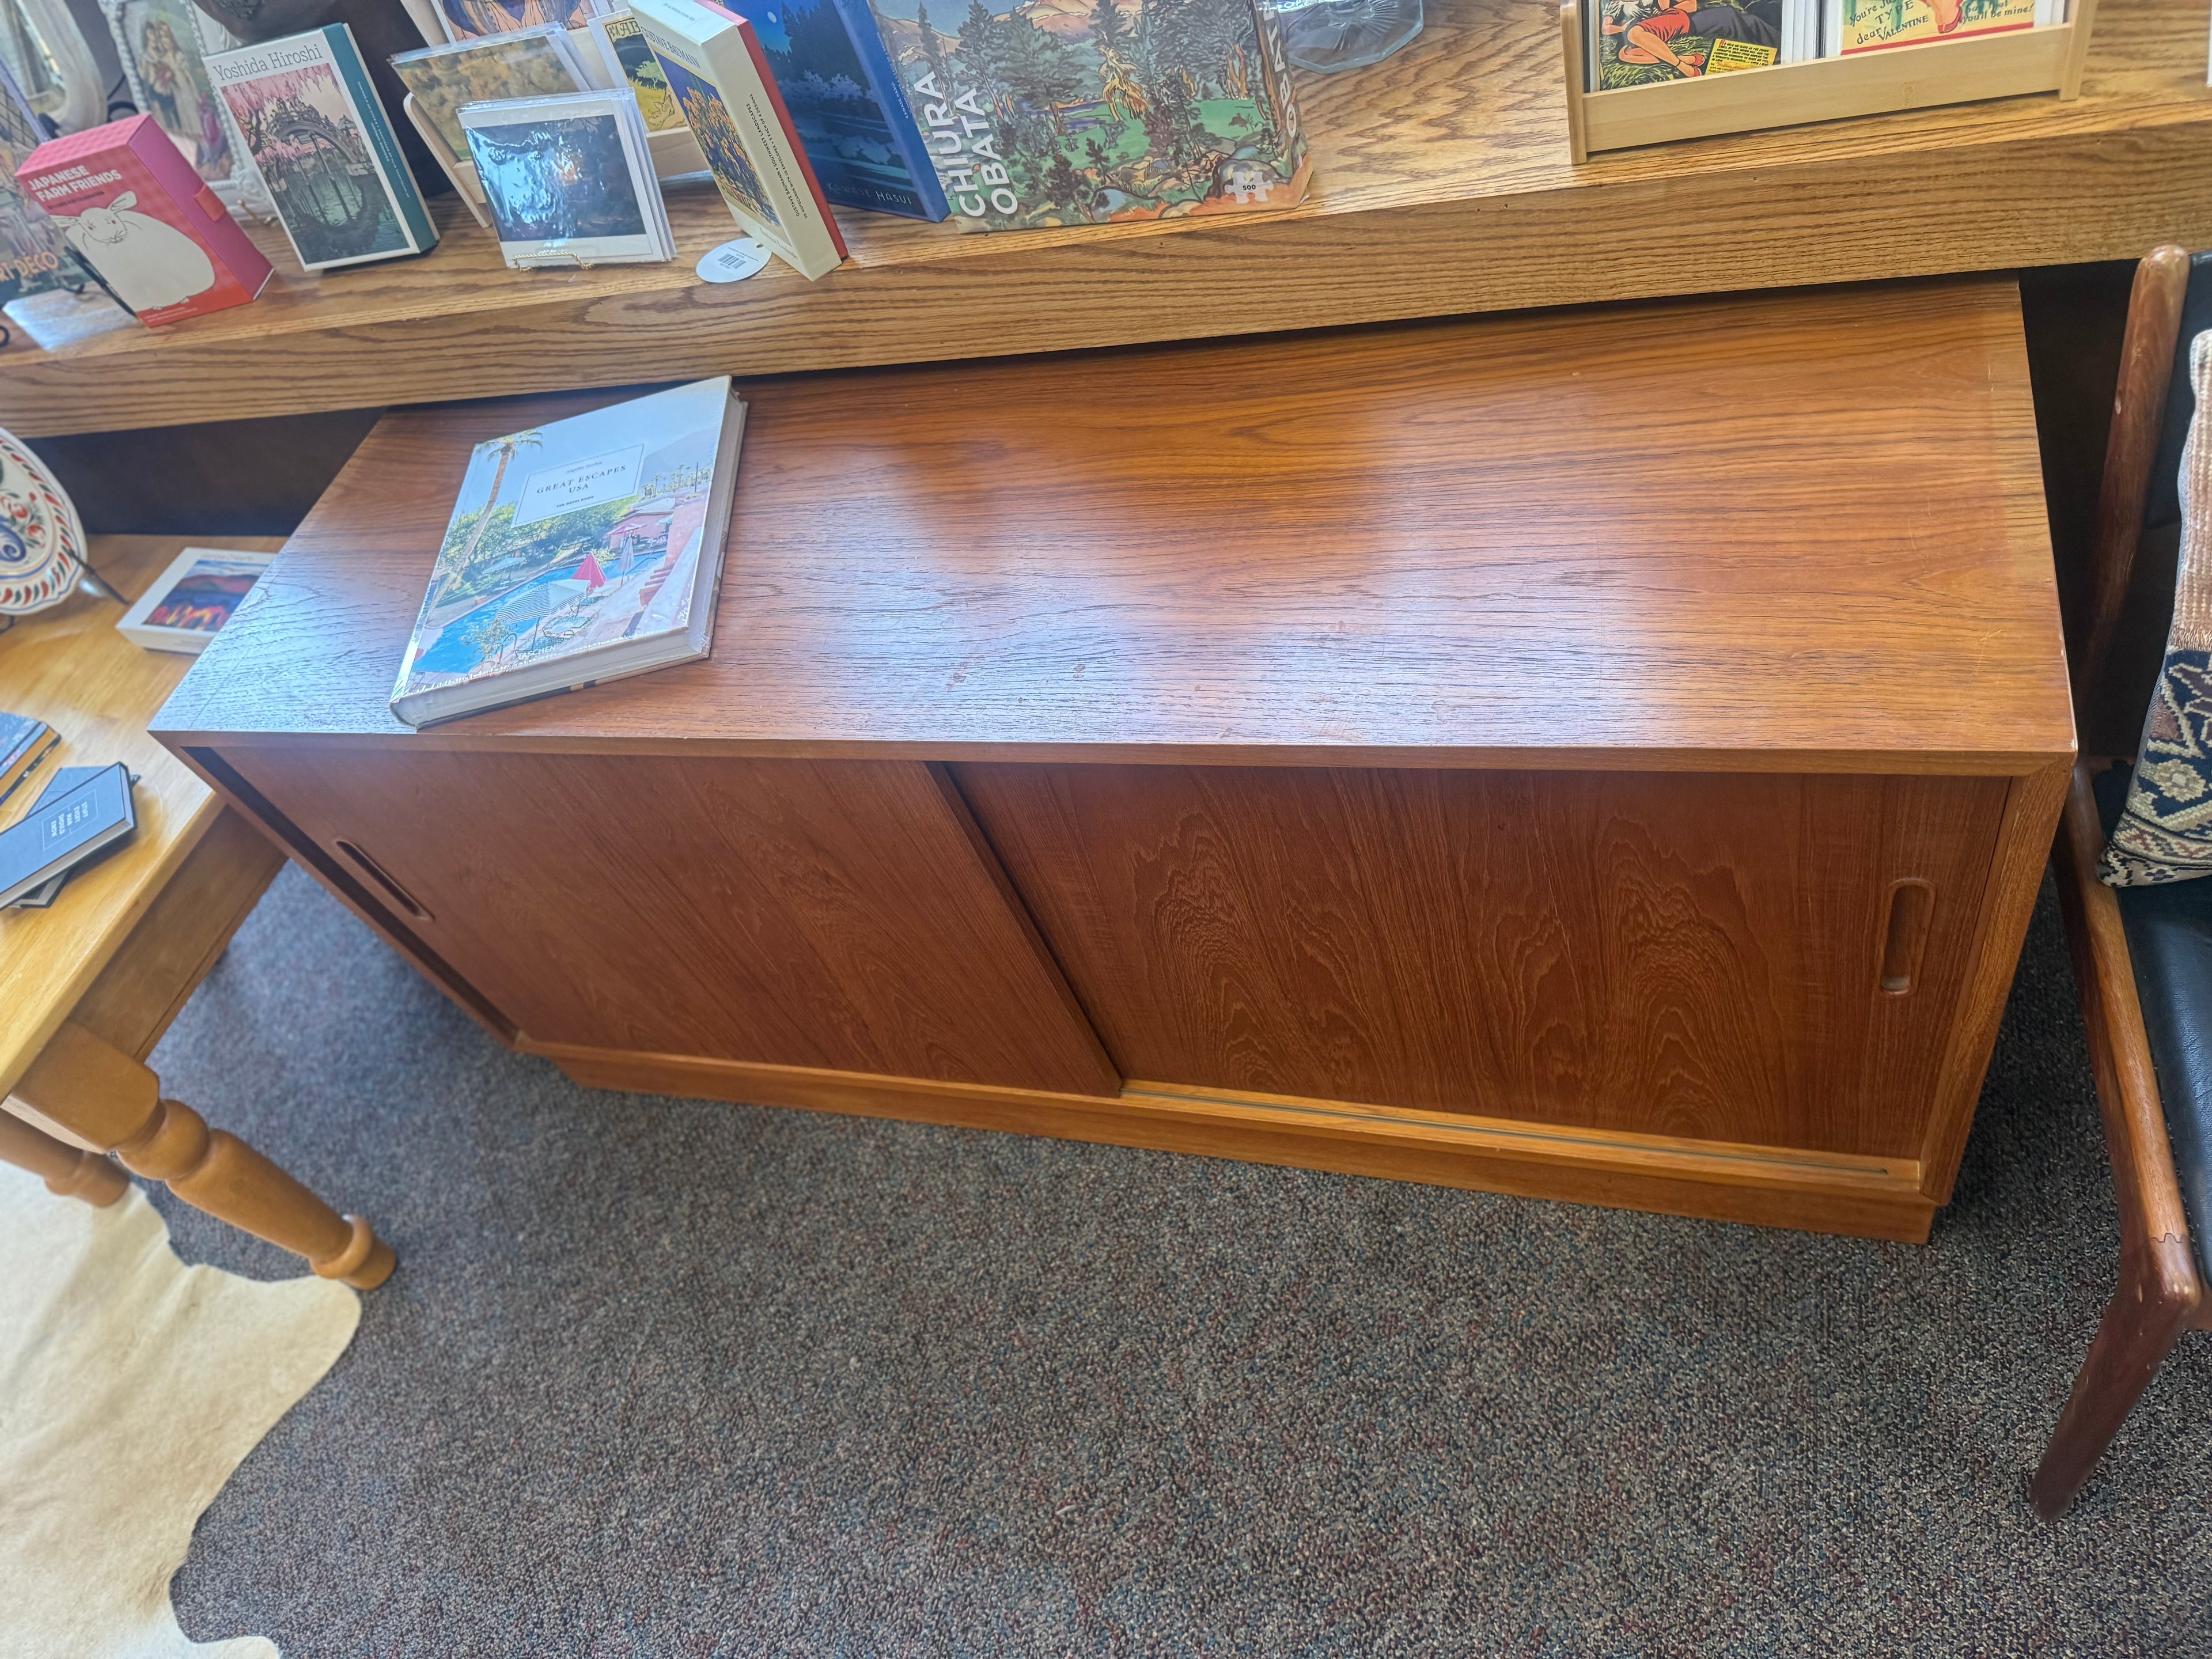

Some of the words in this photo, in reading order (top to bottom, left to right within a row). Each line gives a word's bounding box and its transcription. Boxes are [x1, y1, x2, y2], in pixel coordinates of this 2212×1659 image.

[1857, 27, 1881, 44] dear
[1878, 15, 1929, 41] VALENTINE
[213, 57, 269, 81] Yoshida
[267, 44, 323, 69] Hiroshi
[746, 103, 763, 137] LANDSCAPES
[761, 137, 778, 167] SOUTHWEST
[914, 70, 986, 217] CHIURA
[954, 88, 1018, 215] OBATA
[28, 165, 90, 191] JAPANESE
[35, 183, 71, 202] FARM
[69, 169, 123, 193] FRIENDS
[777, 171, 790, 195] BAUMANN
[788, 195, 800, 217] GUSTAVE
[876, 191, 912, 205] HASUI
[537, 479, 574, 494] GREAT
[578, 465, 626, 483] ESCAPES
[569, 483, 589, 493] USA
[518, 645, 557, 658] TASCHEN
[81, 801, 89, 818] STUFF
[58, 813, 66, 835] SHOULD
